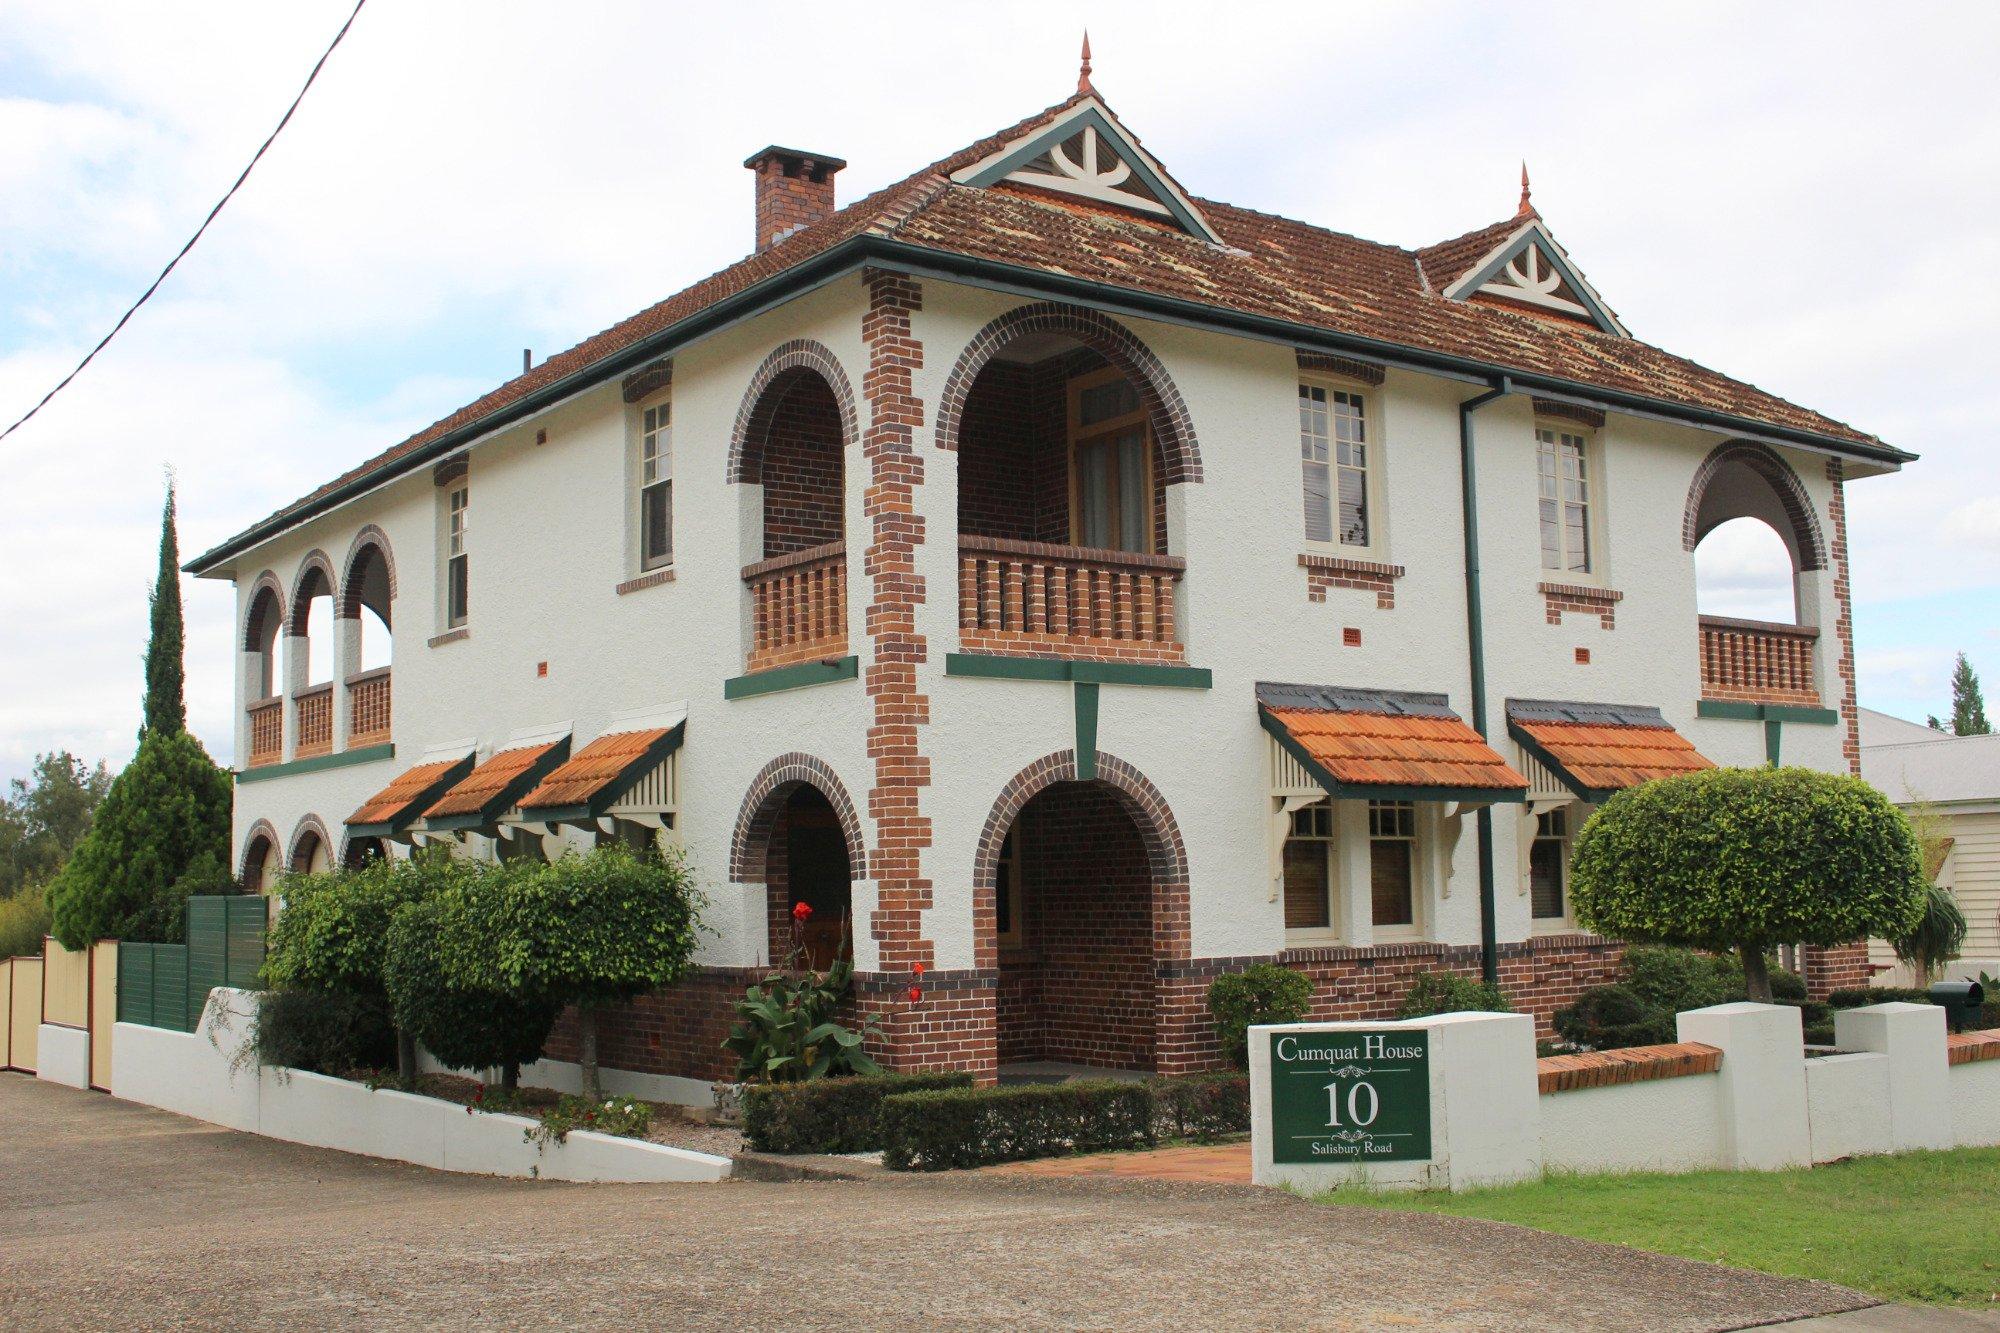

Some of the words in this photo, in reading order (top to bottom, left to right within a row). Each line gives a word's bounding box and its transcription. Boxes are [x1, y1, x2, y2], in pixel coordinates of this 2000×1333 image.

[1277, 1037, 1359, 1064] Cumquat
[1363, 1035, 1422, 1059] House
[1323, 1081, 1379, 1127] 10
[1312, 1142, 1360, 1156] Salisbury
[1364, 1142, 1392, 1154] Road
